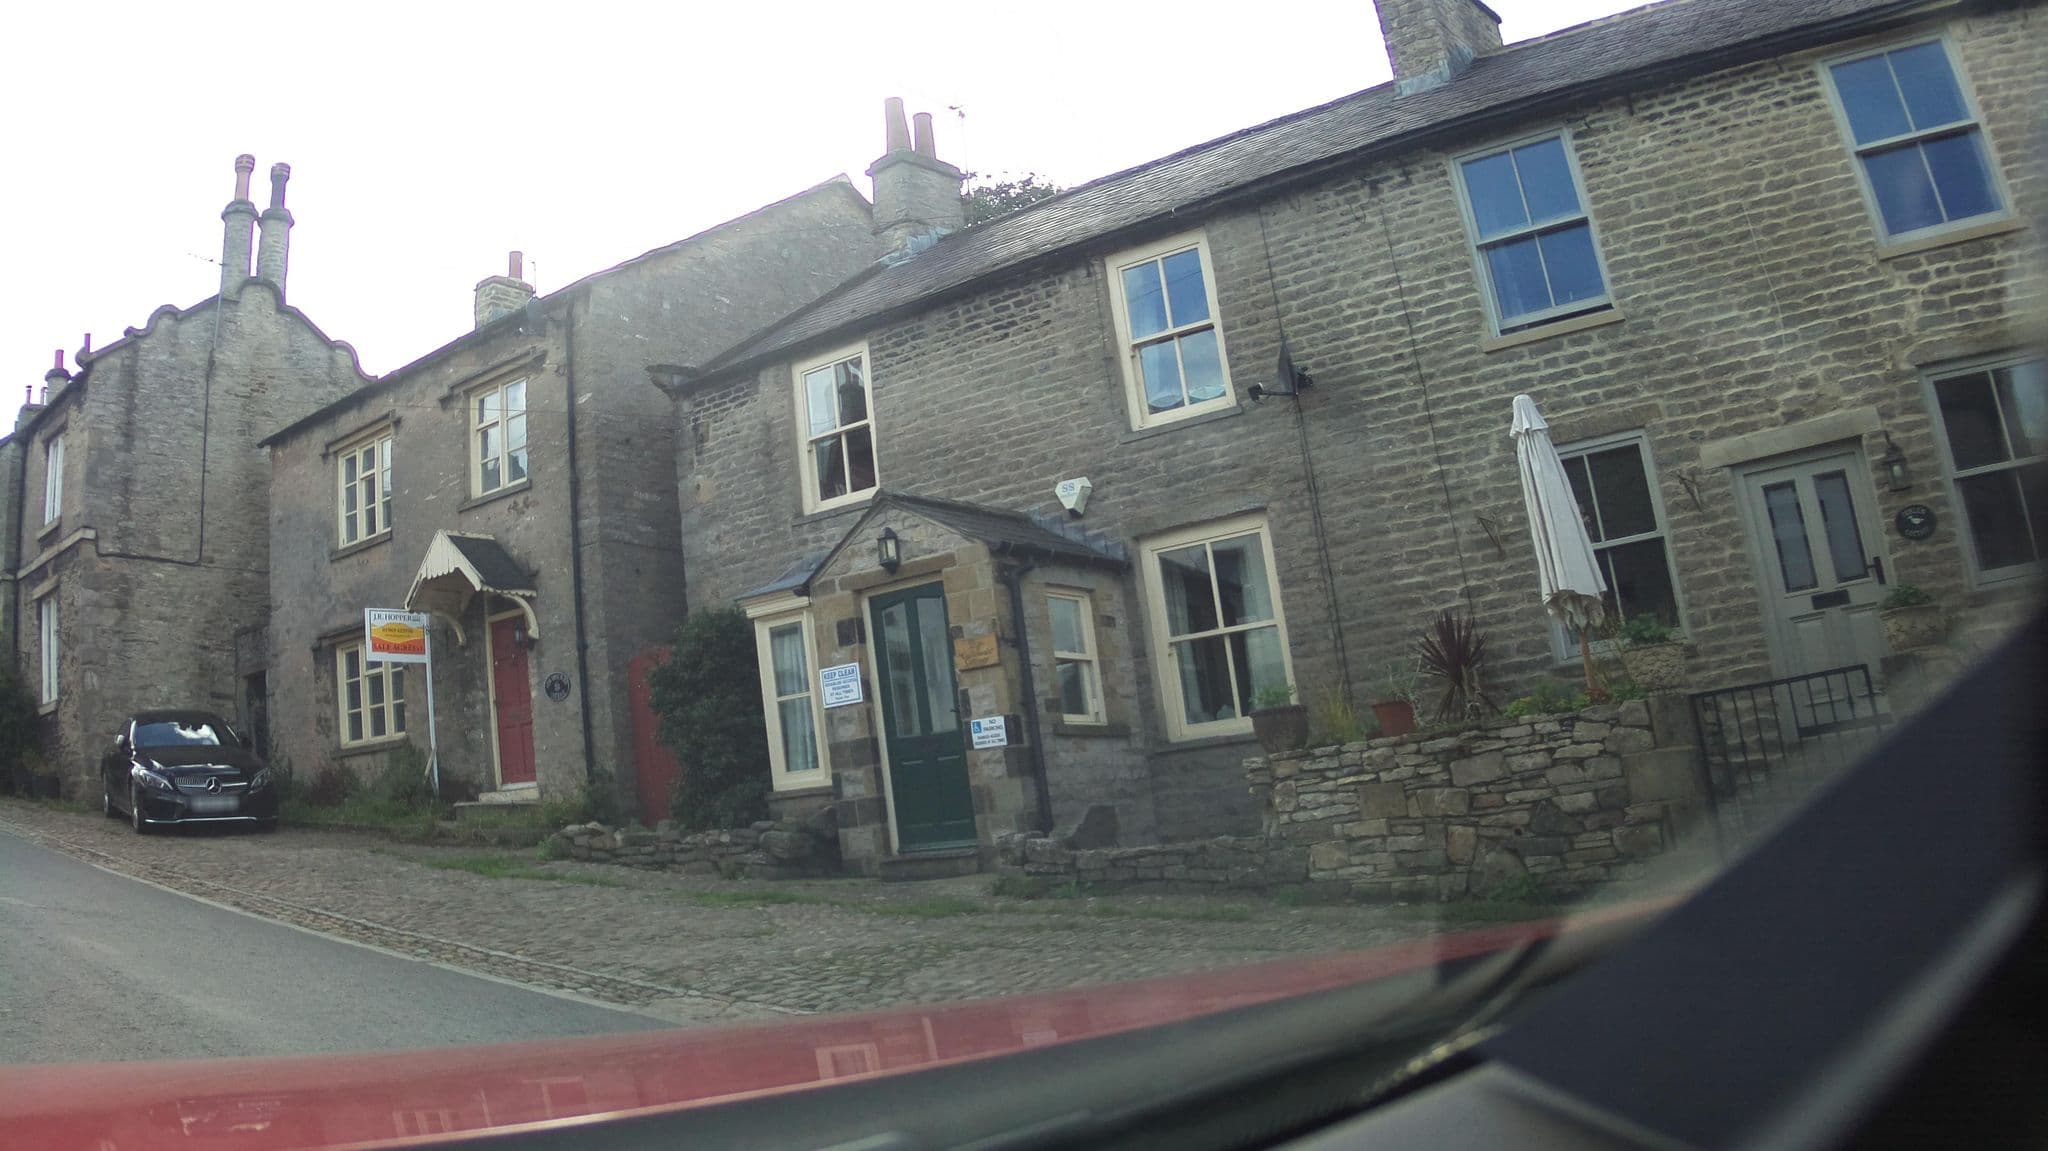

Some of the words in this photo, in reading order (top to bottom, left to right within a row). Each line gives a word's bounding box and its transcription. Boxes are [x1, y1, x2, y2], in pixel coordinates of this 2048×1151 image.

[385, 613, 412, 622] HOPPER
[823, 671, 837, 680] KEEP
[838, 667, 856, 678] CLEAR
